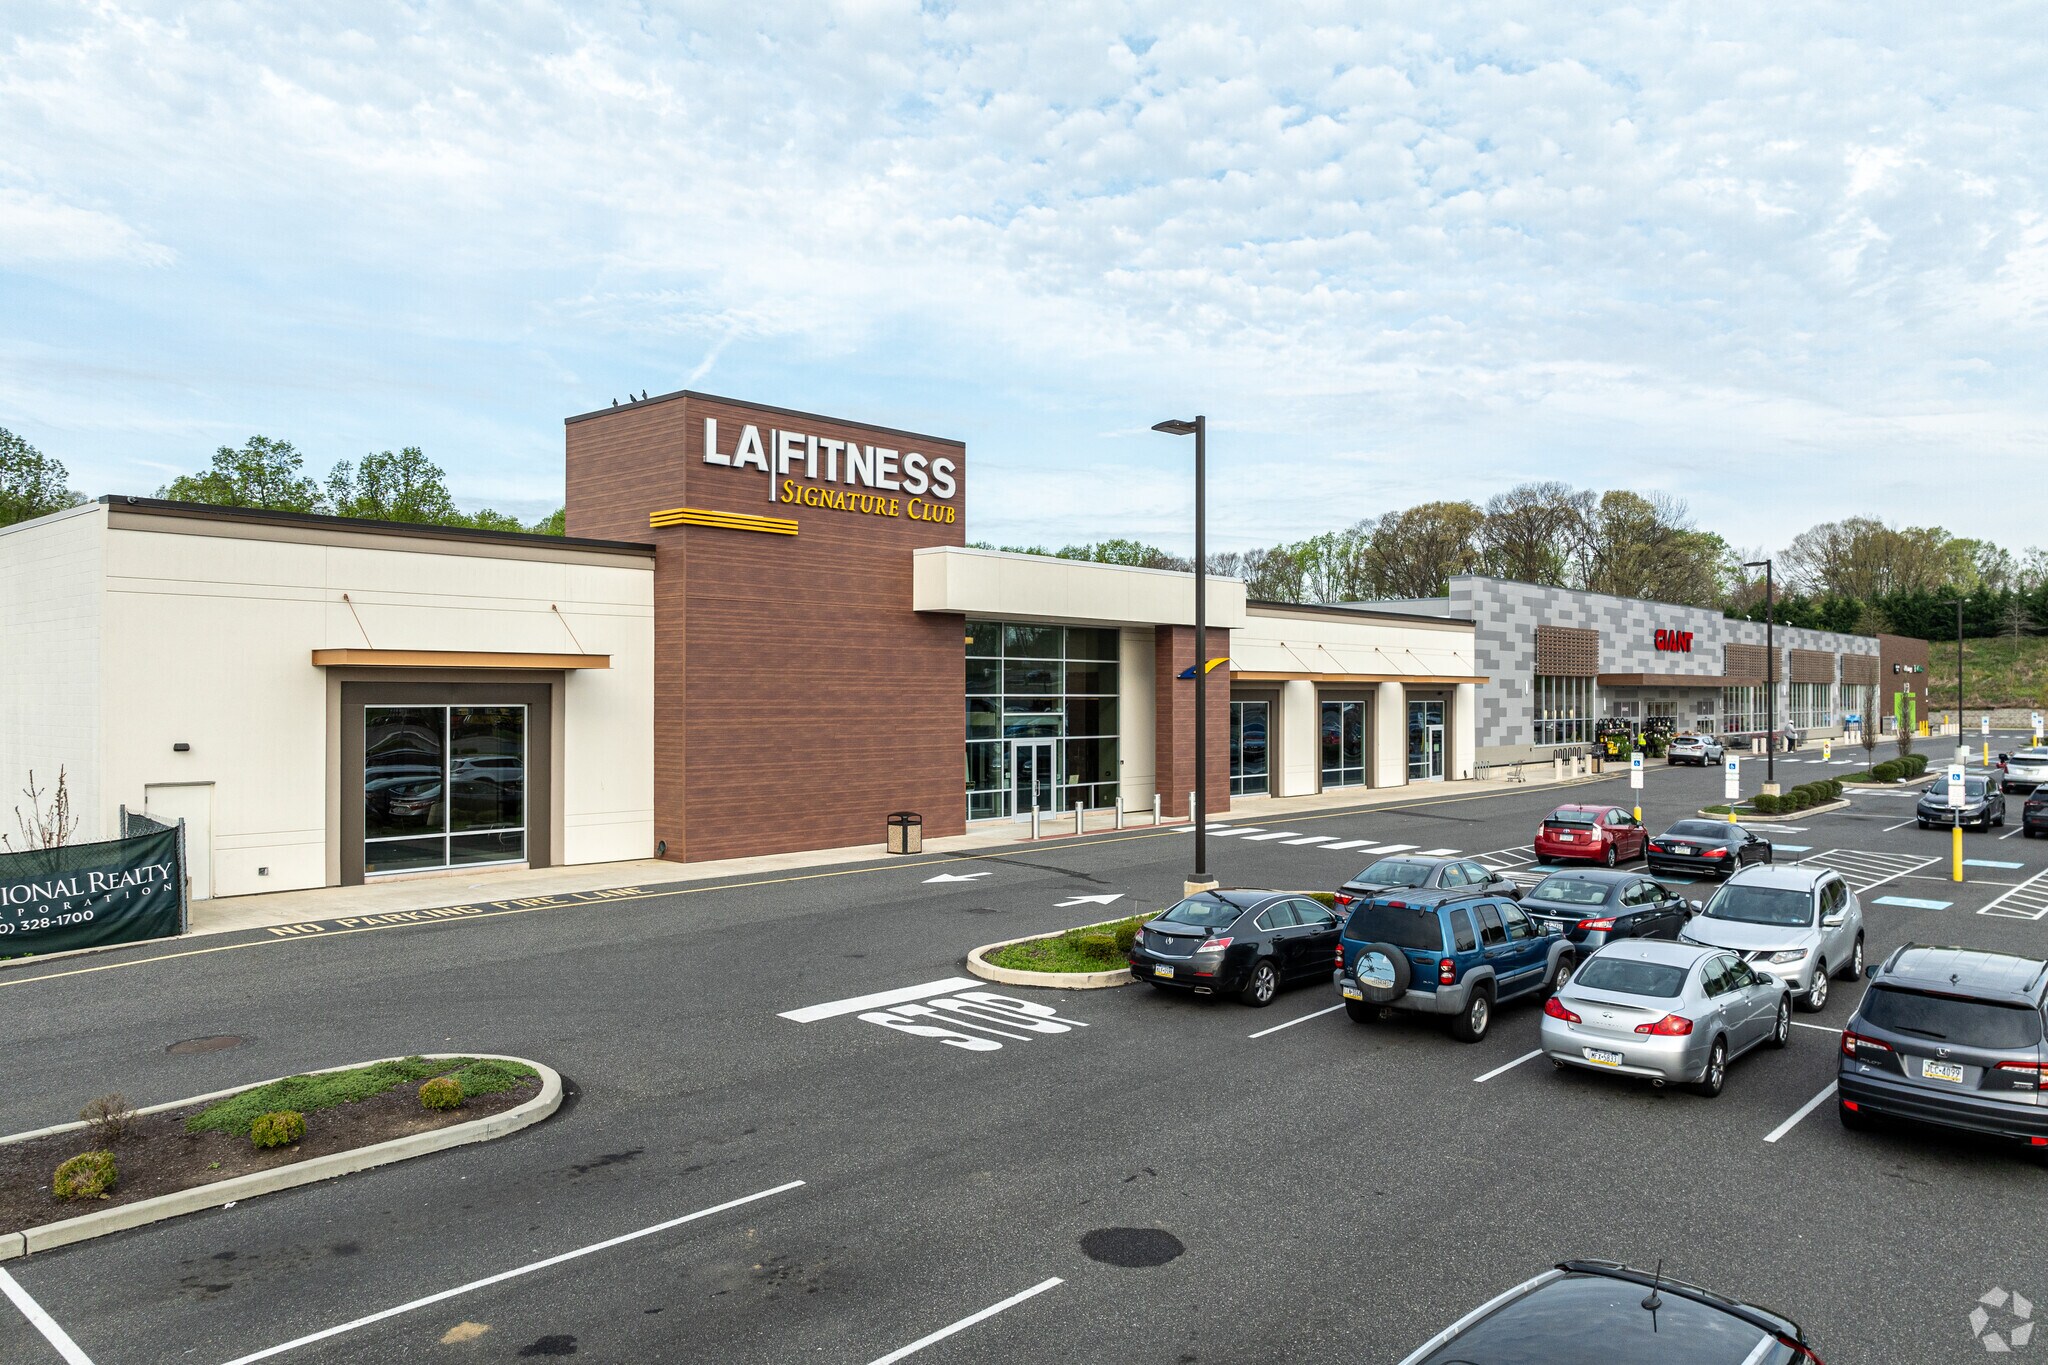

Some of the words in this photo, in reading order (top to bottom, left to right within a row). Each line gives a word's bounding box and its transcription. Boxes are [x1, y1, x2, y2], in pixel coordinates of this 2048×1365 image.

[704, 417, 769, 472] LA
[776, 430, 956, 499] FITNESS
[781, 479, 899, 517] SIGNATURE
[907, 498, 956, 524] CLUB
[1654, 629, 1693, 653] GIANT
[1, 877, 84, 906] IONAL
[87, 862, 172, 893] REALTY
[20, 910, 94, 931] 328-1700
[267, 924, 325, 937] NO
[336, 905, 484, 928] PARKING
[490, 896, 568, 910] FIRE
[572, 887, 654, 900] LANE
[857, 991, 1090, 1051] STOP
